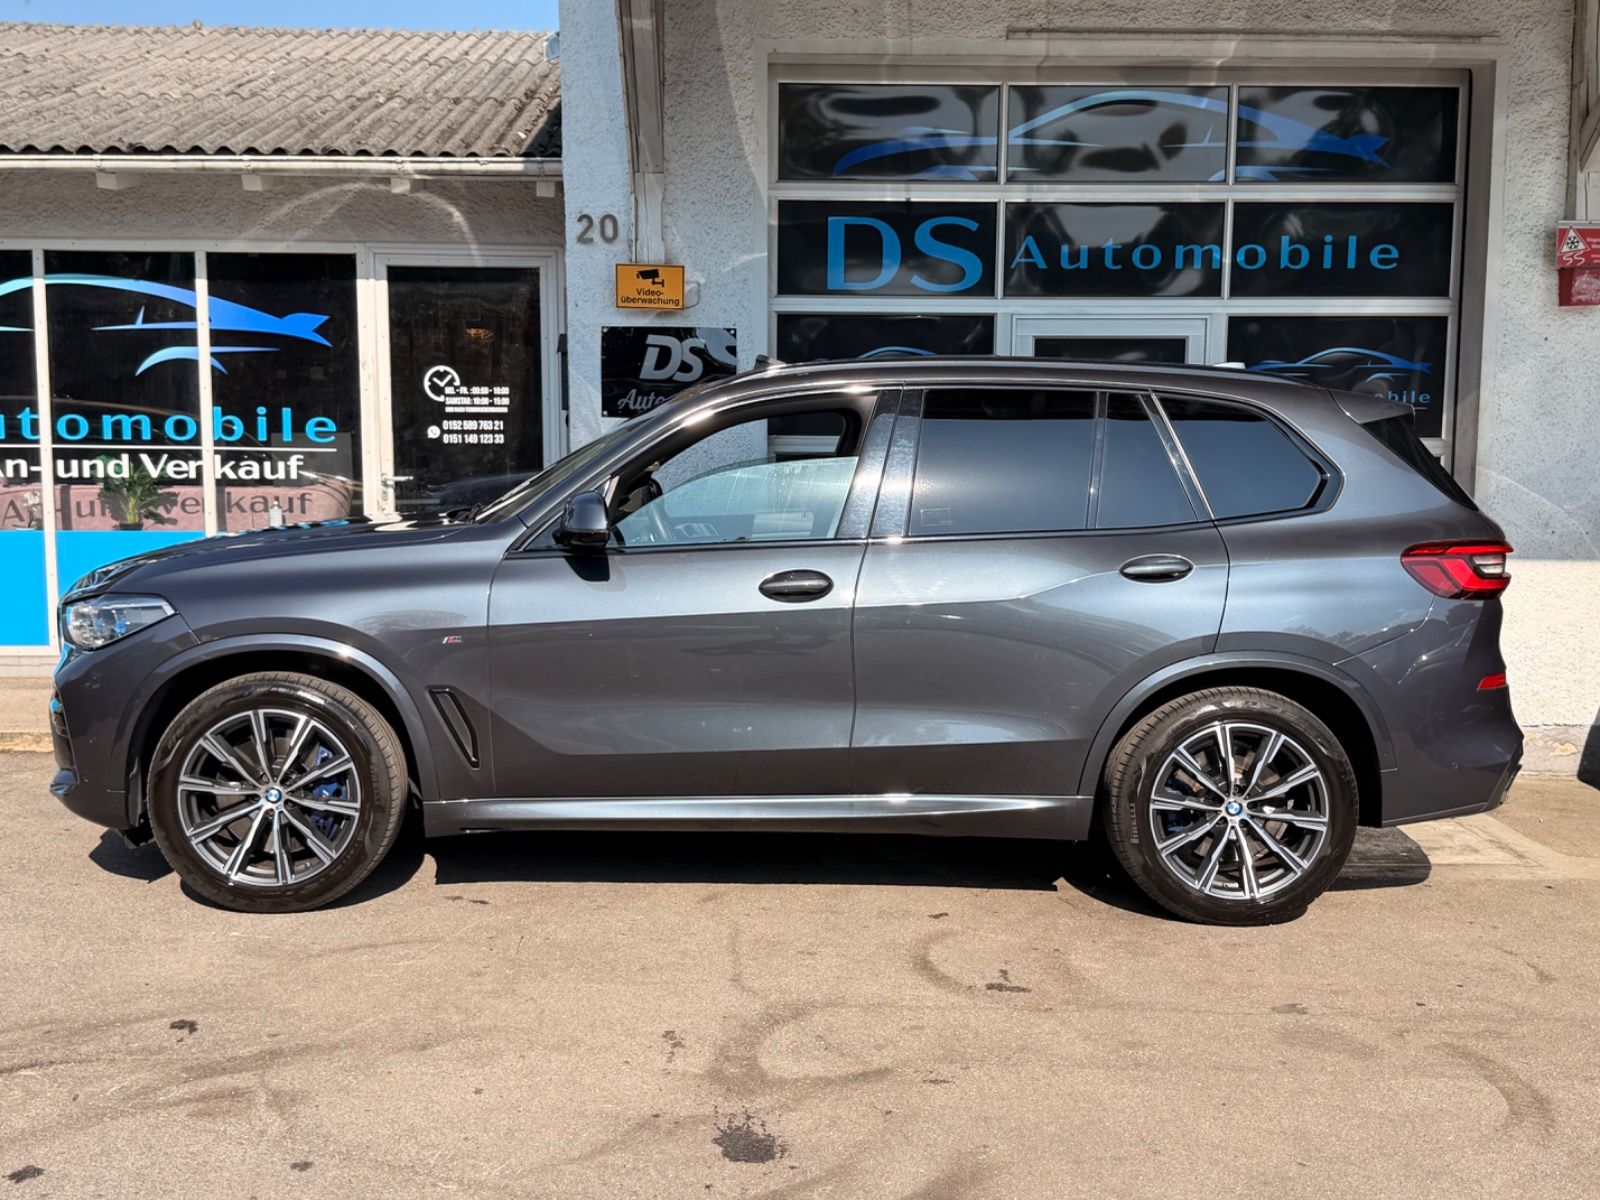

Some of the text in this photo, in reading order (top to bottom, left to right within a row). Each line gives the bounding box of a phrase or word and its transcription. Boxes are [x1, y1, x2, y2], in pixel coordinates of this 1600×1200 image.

[576, 214, 618, 244] 20
[827, 216, 1400, 292] DS Automobile
[621, 296, 680, 307] überwachung
[636, 288, 664, 297] Video-
[639, 334, 704, 382] DS
[0, 406, 337, 443] tomobile
[494, 420, 504, 430] 21
[443, 433, 462, 444] 0151
[0, 454, 304, 480] n- und Verkauf
